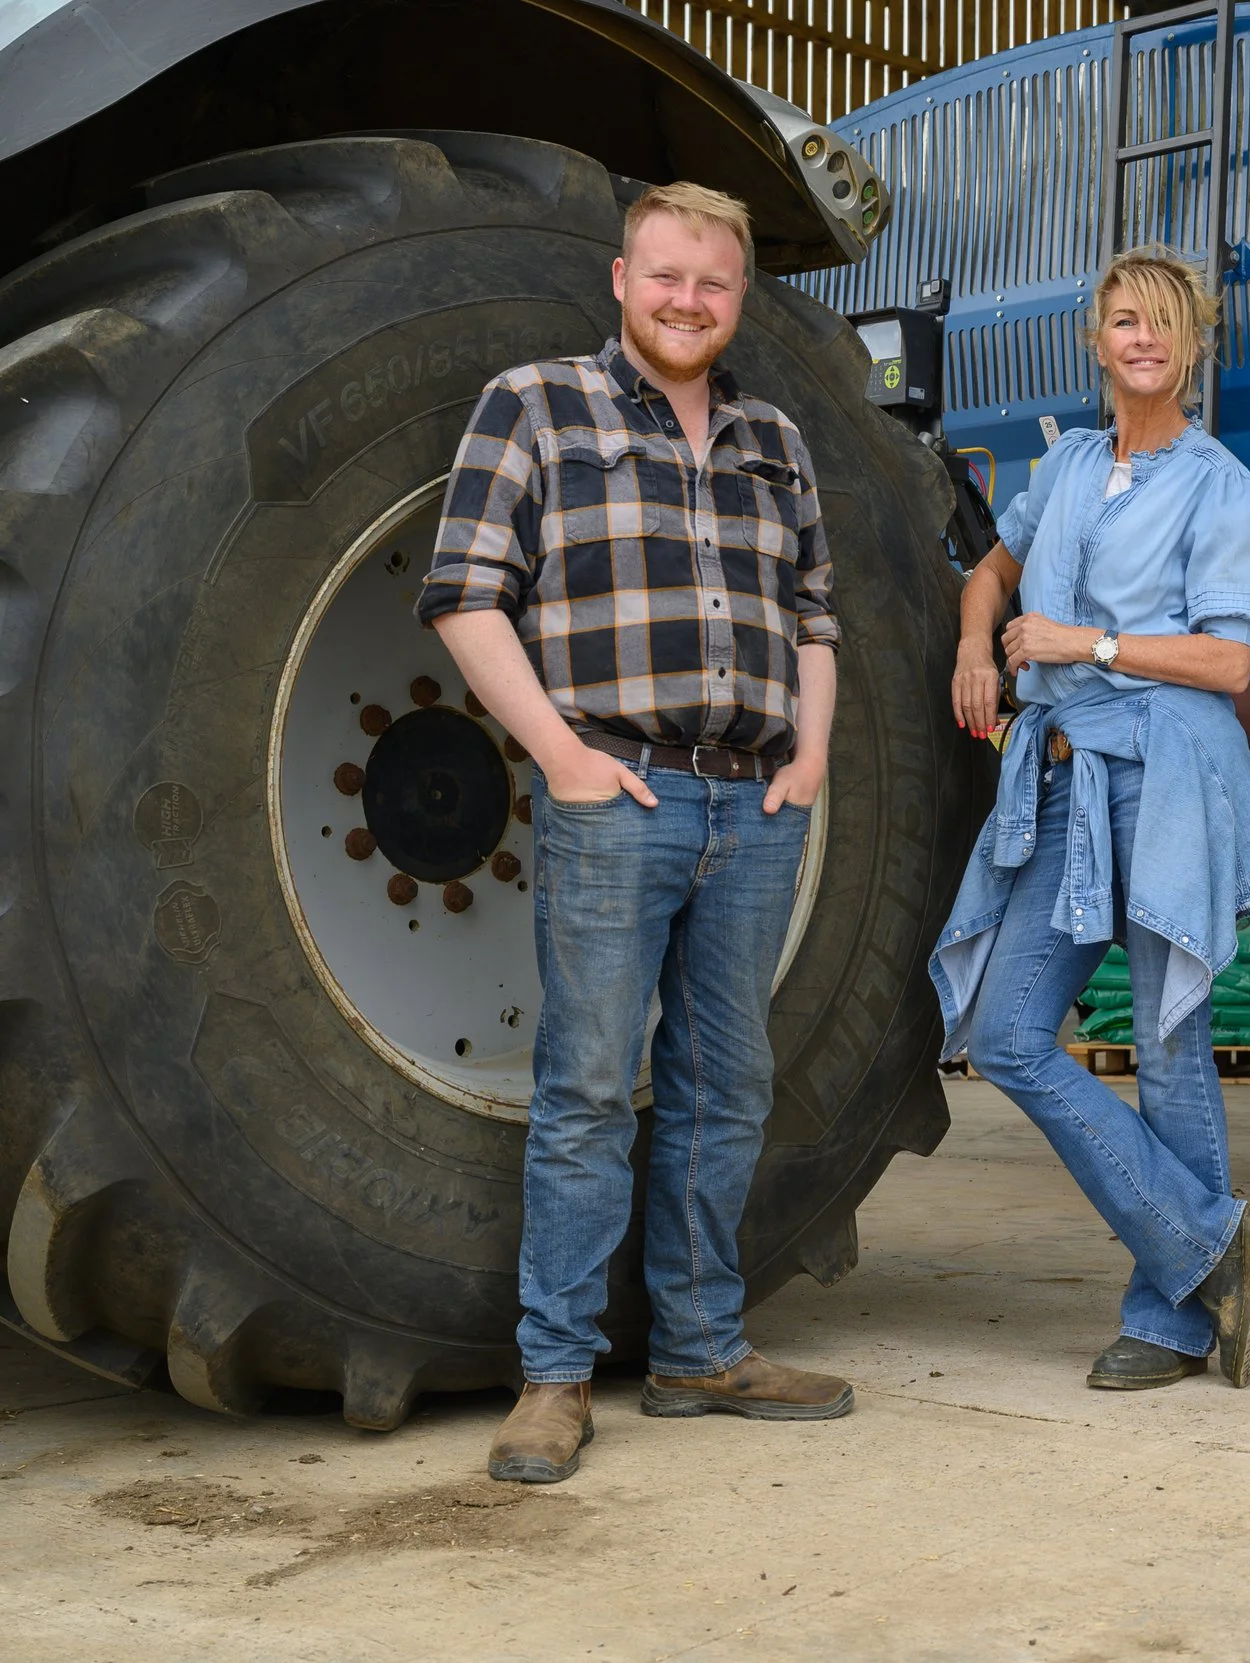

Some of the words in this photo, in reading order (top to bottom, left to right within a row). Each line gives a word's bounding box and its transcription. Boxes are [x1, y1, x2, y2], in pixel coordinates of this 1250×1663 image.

[278, 397, 333, 464] VF
[339, 331, 480, 423] 650/85
[160, 798, 172, 837] HIGH
[172, 785, 180, 838] TRACTION
[805, 649, 931, 1118] MICHELIN
